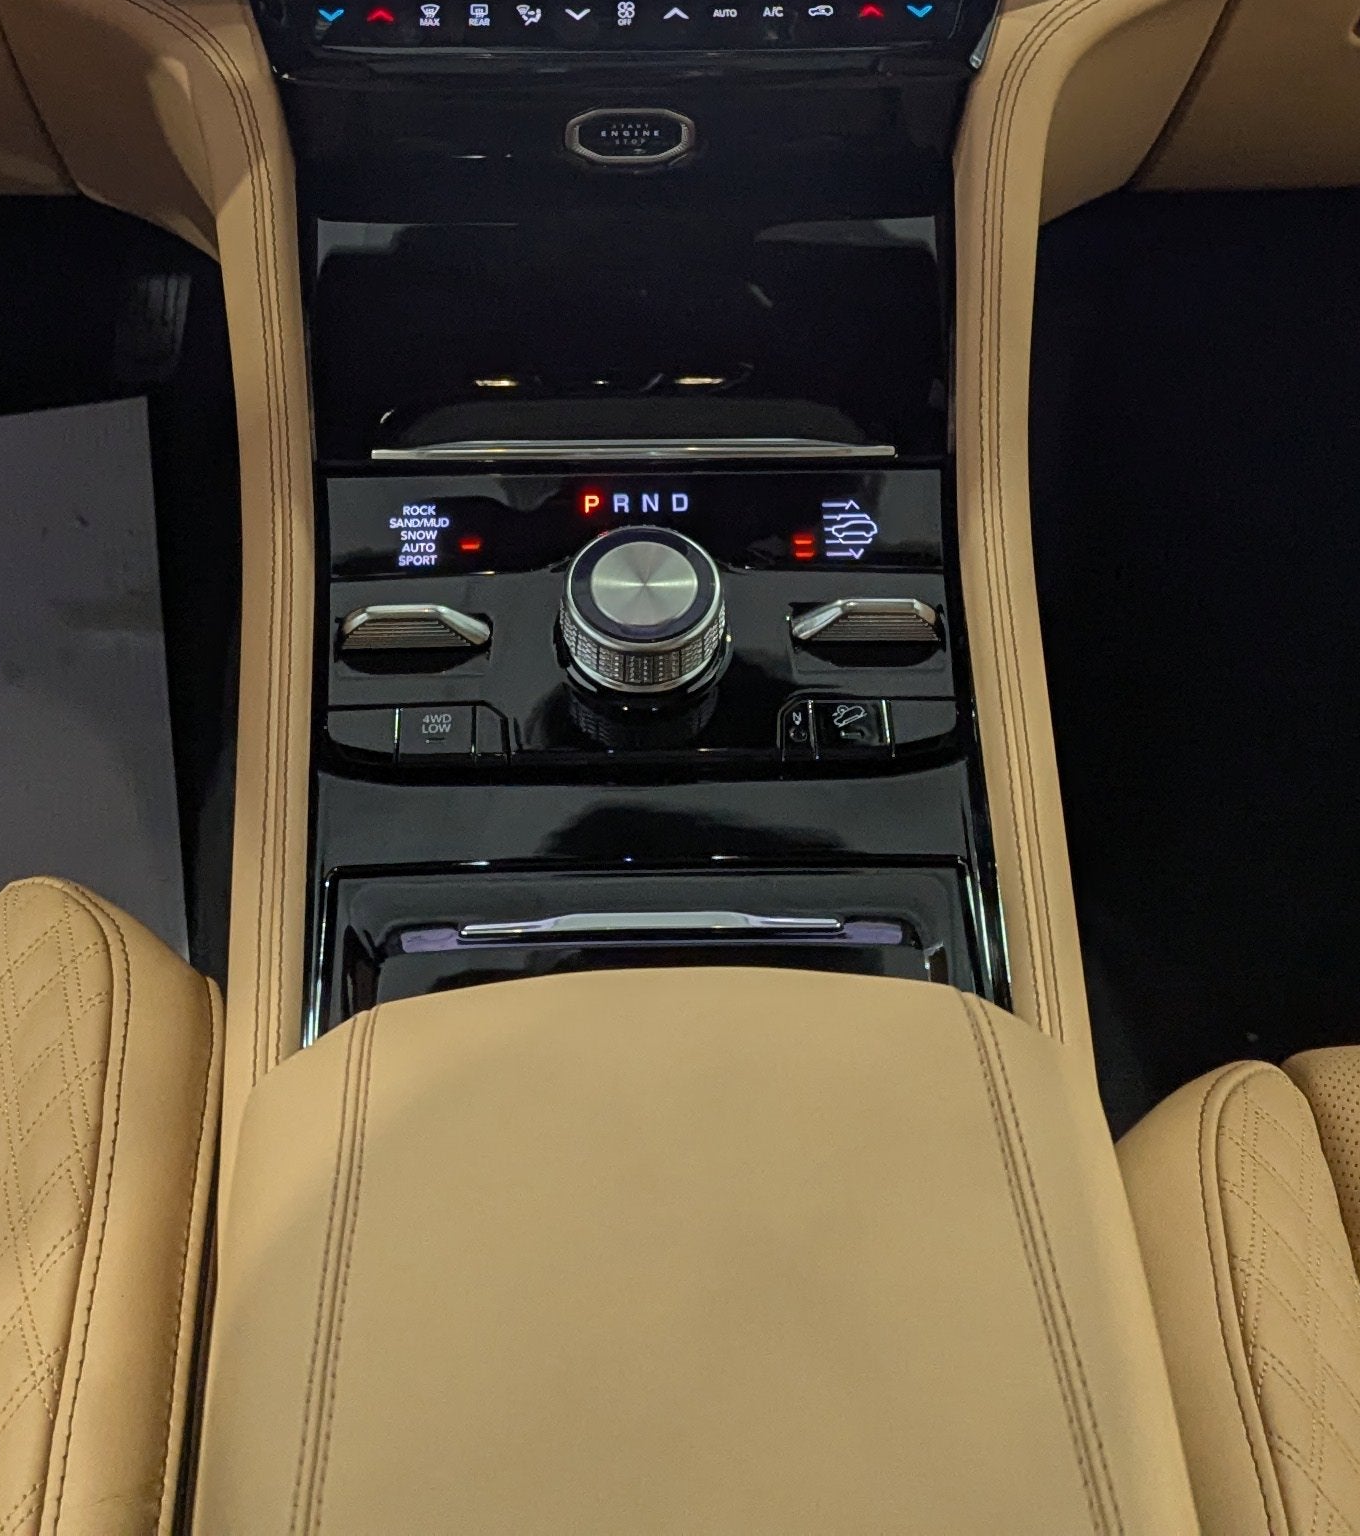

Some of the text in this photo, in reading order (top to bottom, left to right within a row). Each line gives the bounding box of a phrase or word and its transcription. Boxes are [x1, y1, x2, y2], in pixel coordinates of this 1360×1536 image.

[713, 9, 738, 18] AUTO
[763, 6, 784, 17] A/C
[419, 18, 440, 26] MAX
[468, 18, 490, 26] REAR
[617, 18, 632, 26] OFF
[584, 493, 689, 513] P R N D
[402, 505, 436, 516] ROCK
[389, 517, 450, 528] SAND/MUD
[400, 530, 438, 541] SNOW
[401, 542, 436, 553] AUTO
[398, 555, 438, 566] SPORT
[422, 713, 452, 723] 4WD
[422, 724, 452, 734] LOW
